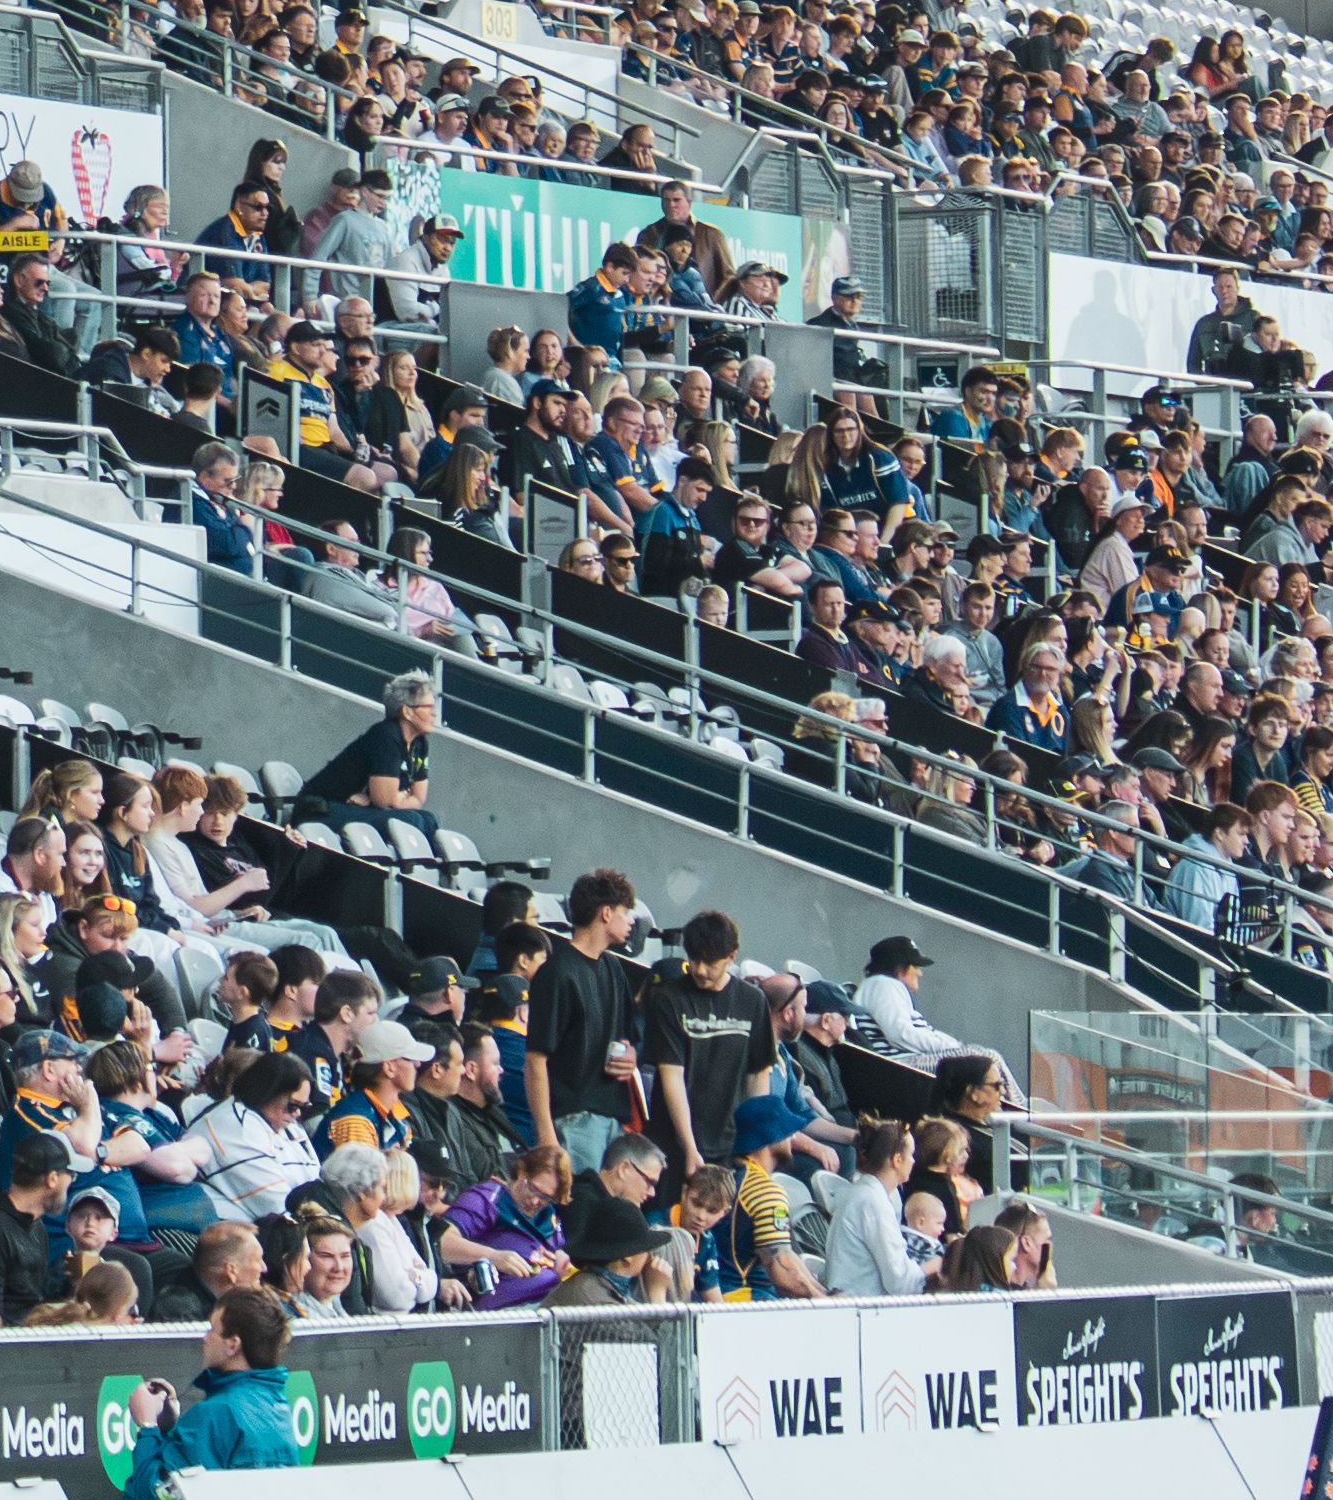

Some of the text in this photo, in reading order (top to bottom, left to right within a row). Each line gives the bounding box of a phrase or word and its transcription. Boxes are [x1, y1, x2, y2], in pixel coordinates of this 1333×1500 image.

[485, 3, 512, 38] 303
[1, 235, 41, 247] AISLE
[411, 1380, 530, 1437] GO Media
[769, 1377, 844, 1438] WAE
[925, 1370, 1000, 1430] WAE
[1027, 1360, 1144, 1427] SPEIGHT'S
[1170, 1355, 1283, 1417] SPEIGHT'S
[2, 1403, 85, 1459] Media
[325, 1389, 397, 1445] Media
